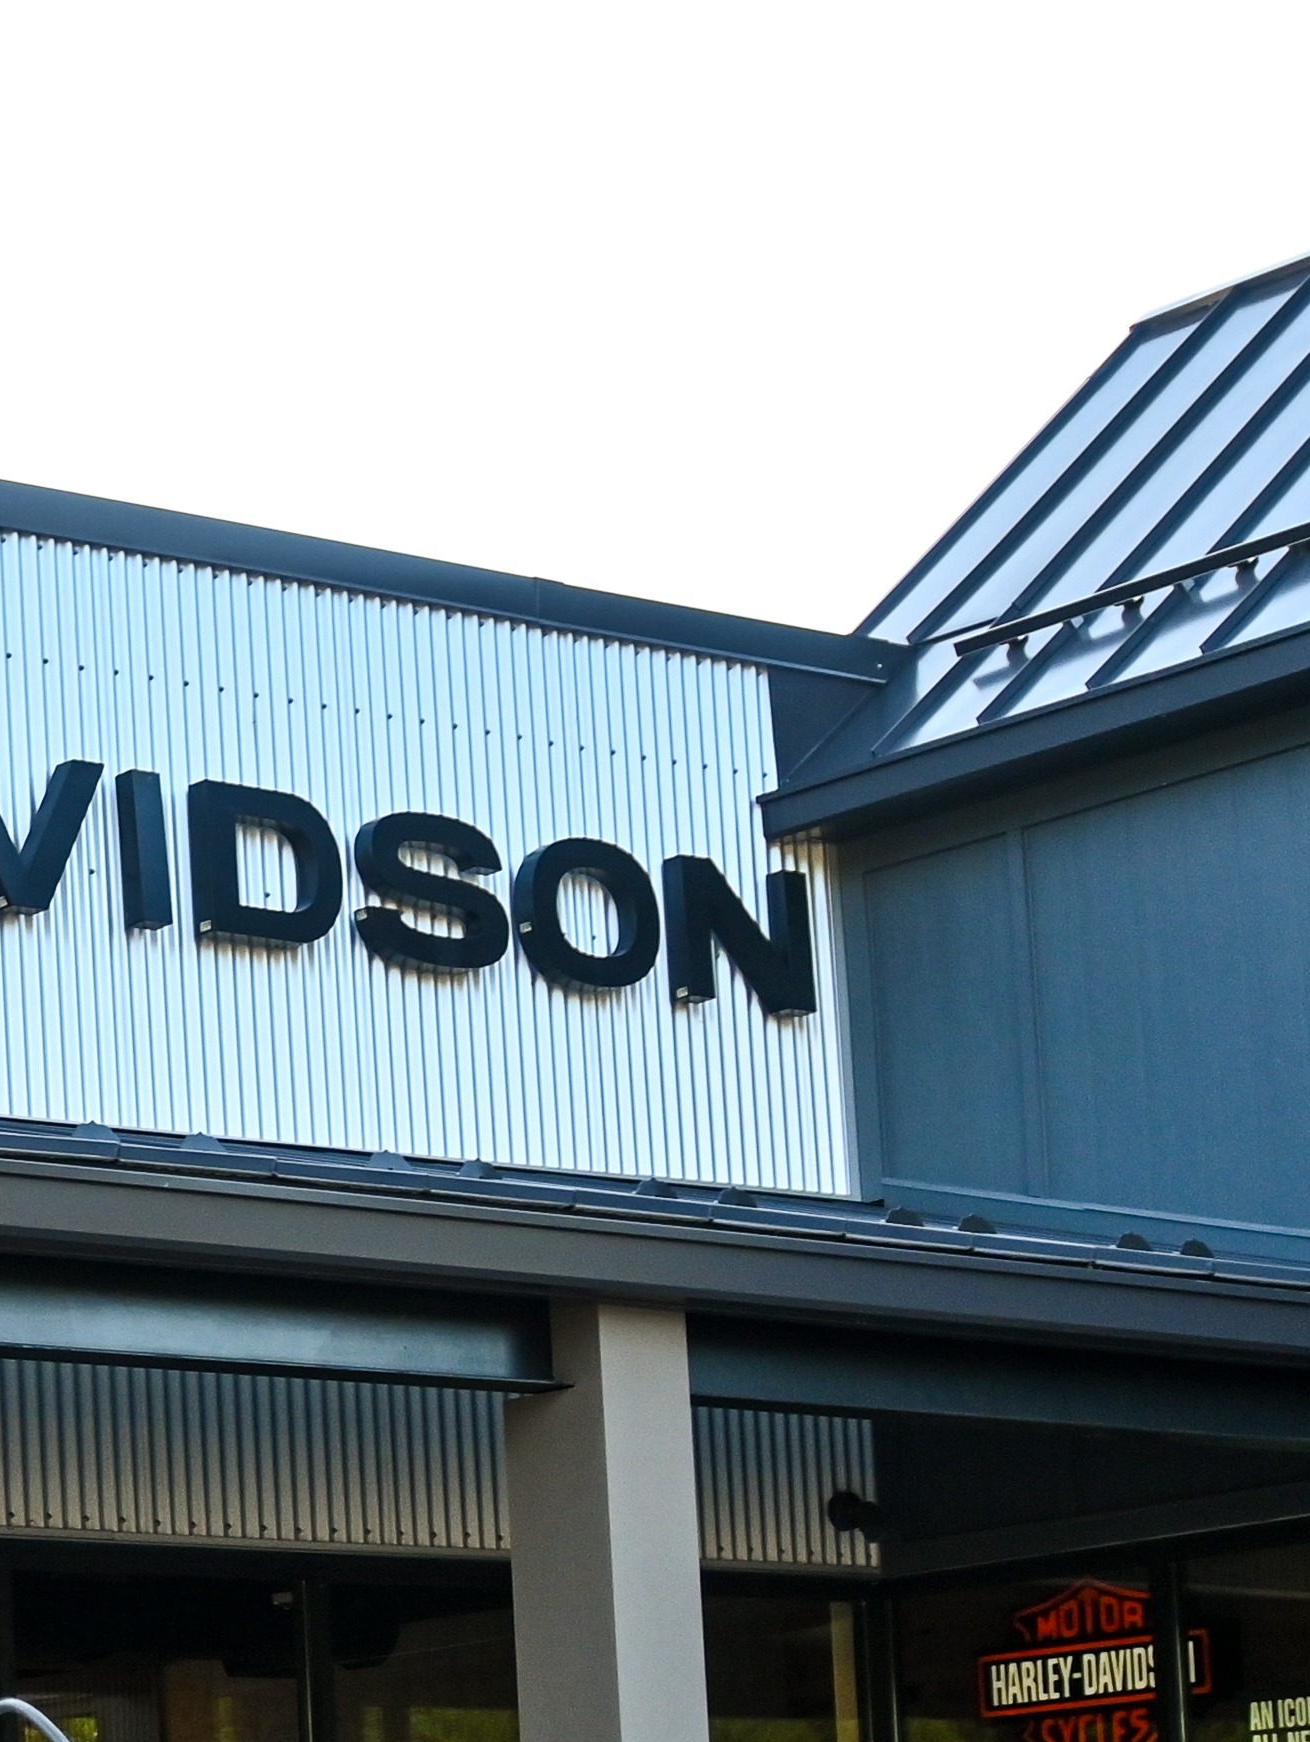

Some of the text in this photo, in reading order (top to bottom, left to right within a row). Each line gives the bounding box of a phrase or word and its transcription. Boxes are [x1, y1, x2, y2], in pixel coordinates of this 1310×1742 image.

[1037, 1594, 1145, 1642] MOTOR
[1250, 1697, 1310, 1731] AN ICO
